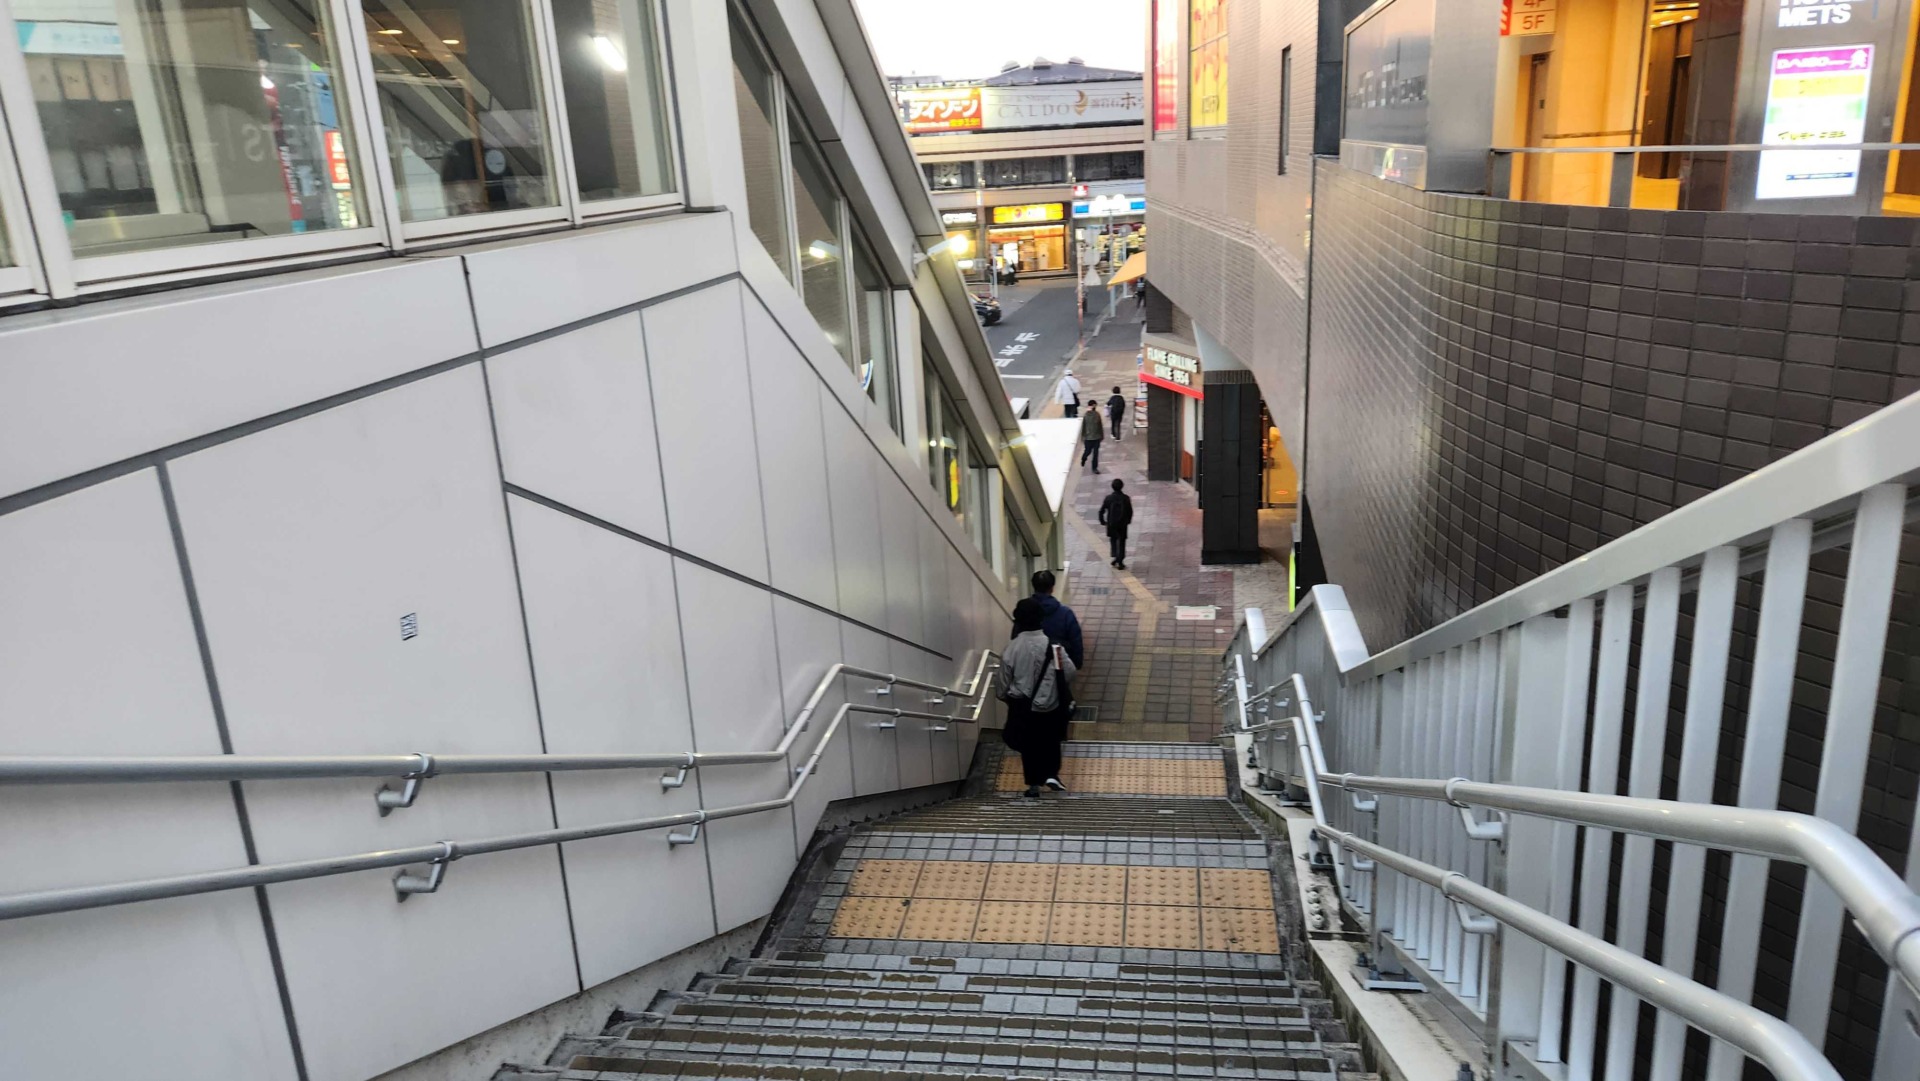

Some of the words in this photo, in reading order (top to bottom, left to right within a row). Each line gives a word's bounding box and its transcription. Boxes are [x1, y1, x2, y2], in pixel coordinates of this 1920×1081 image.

[1522, 14, 1546, 30] 5F
[1778, 3, 1852, 28] METS
[998, 102, 1071, 119] CALDO
